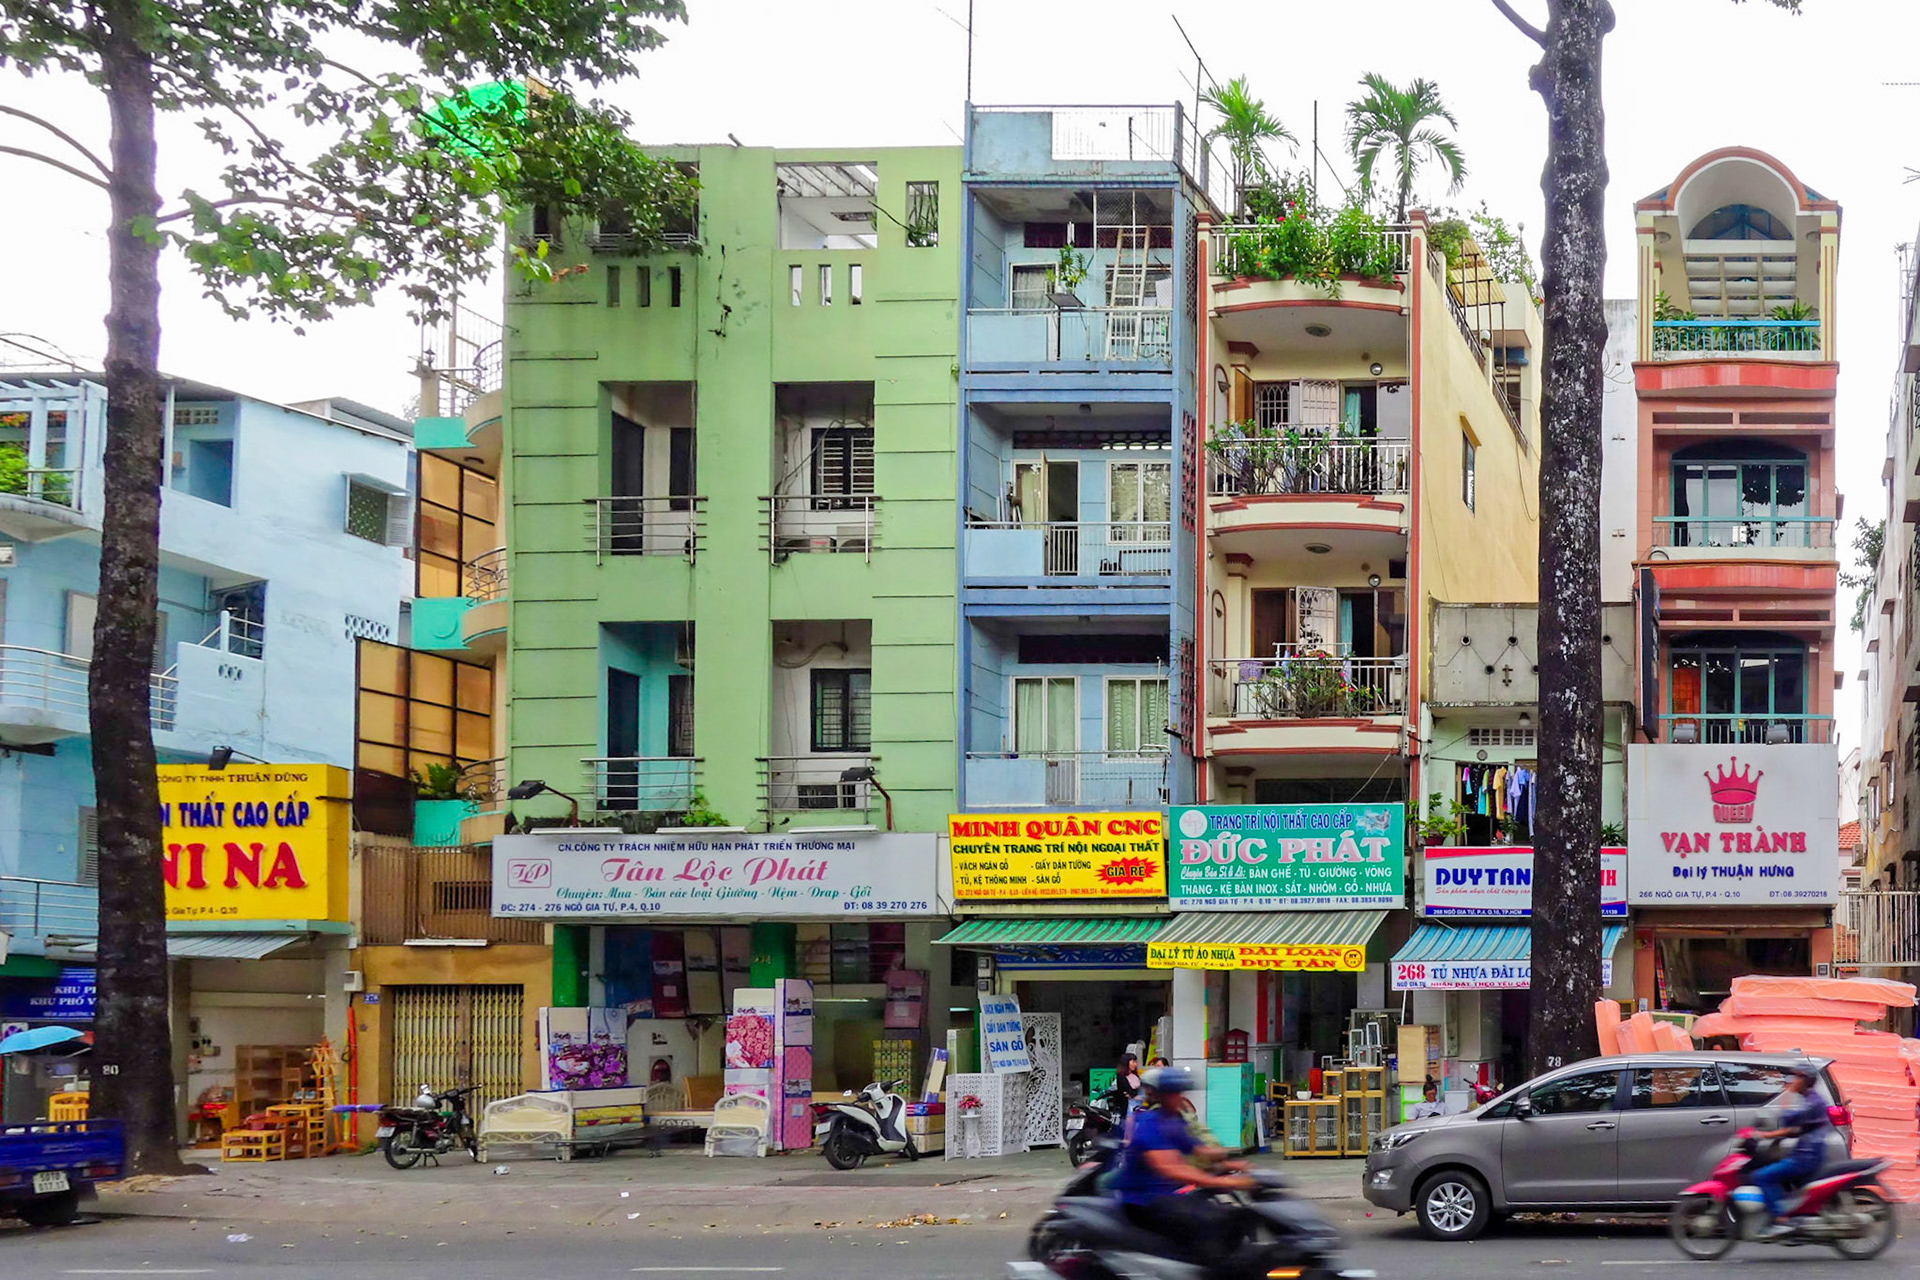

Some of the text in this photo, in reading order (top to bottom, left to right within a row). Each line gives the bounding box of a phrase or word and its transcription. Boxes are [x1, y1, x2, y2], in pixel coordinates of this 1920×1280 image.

[185, 775, 196, 783] TY
[200, 775, 224, 783] TNHH
[178, 791, 225, 828] THẤT
[233, 801, 268, 827] CAO
[274, 790, 309, 827] CẤP
[1713, 803, 1754, 822] QUEEN
[952, 820, 1021, 838] MINH
[1025, 815, 1102, 840] QUÂN
[1107, 819, 1161, 836] CNC
[1209, 813, 1242, 830] TRANG
[1244, 809, 1261, 830] TRÍ
[1263, 809, 1280, 833] NỘI
[1282, 808, 1308, 829] THẤT
[1310, 813, 1330, 829] CAO
[1332, 807, 1353, 829] CẤP
[603, 843, 615, 852] TY
[619, 841, 650, 851] TRÁCH
[654, 841, 685, 852] NHIỆM
[688, 840, 708, 851] HỮU
[711, 842, 732, 852] HẠN
[735, 841, 760, 851] PHÁT
[763, 839, 792, 851] TRIỂN
[795, 841, 834, 851] THƯƠNG
[837, 842, 855, 852] MẠI
[953, 839, 1160, 855] CHUYÊN TRANG TRÍ NỘI NGOẠI THẤT
[1179, 830, 1391, 865] ĐỨC PHÁT
[1660, 825, 1807, 859] VẠN THÀNH
[223, 842, 306, 889] NA
[601, 856, 829, 887] Tân Lộc Phát
[959, 861, 977, 870] VÁCH
[1035, 858, 1051, 870] GIẤY
[1107, 861, 1145, 876] GIÁ RẺ
[1249, 865, 1268, 878] BÀN
[1271, 864, 1292, 878] GHẾ
[1299, 865, 1311, 878] TỦ
[1318, 864, 1357, 878] GIƯỜNG
[1364, 864, 1392, 877] VÕNG
[985, 873, 1008, 884] THÔNG
[1009, 875, 1027, 884] MINH
[1036, 873, 1050, 884] SÀN
[1435, 868, 1531, 886] DUYTAN
[1672, 863, 1795, 881] Đại lý THUẬN HƯNG
[557, 885, 872, 901] Chuyên: Mua Bán các loại Giường Nệm Drap Gối
[1180, 878, 1392, 896] THANG KỆ BÀN INOX SẮT NHÔM GỖ NHỰA
[1655, 889, 1673, 898] NGÔ
[519, 903, 535, 911] 274
[545, 903, 561, 912] 276
[564, 902, 583, 912] NGÔ
[585, 903, 600, 911] GIA
[640, 903, 661, 912] Q.10
[861, 901, 873, 910] 08
[876, 901, 887, 910] 39
[890, 901, 907, 909] 270
[910, 901, 927, 909] 276
[1150, 945, 1235, 961] ĐẠI TỦ ÁO NHỰA
[1240, 947, 1342, 957] ĐÀI LOAN
[1241, 959, 1284, 967] DUY
[1292, 958, 1338, 968] TÂN
[1397, 964, 1513, 981] 268 TỦ NHỰA ĐÀI
[54, 986, 81, 994] KHU
[30, 995, 84, 1005] KHU PHỐ
[989, 1034, 1024, 1053] SÀN GỖ
[1548, 1056, 1561, 1067] 78
